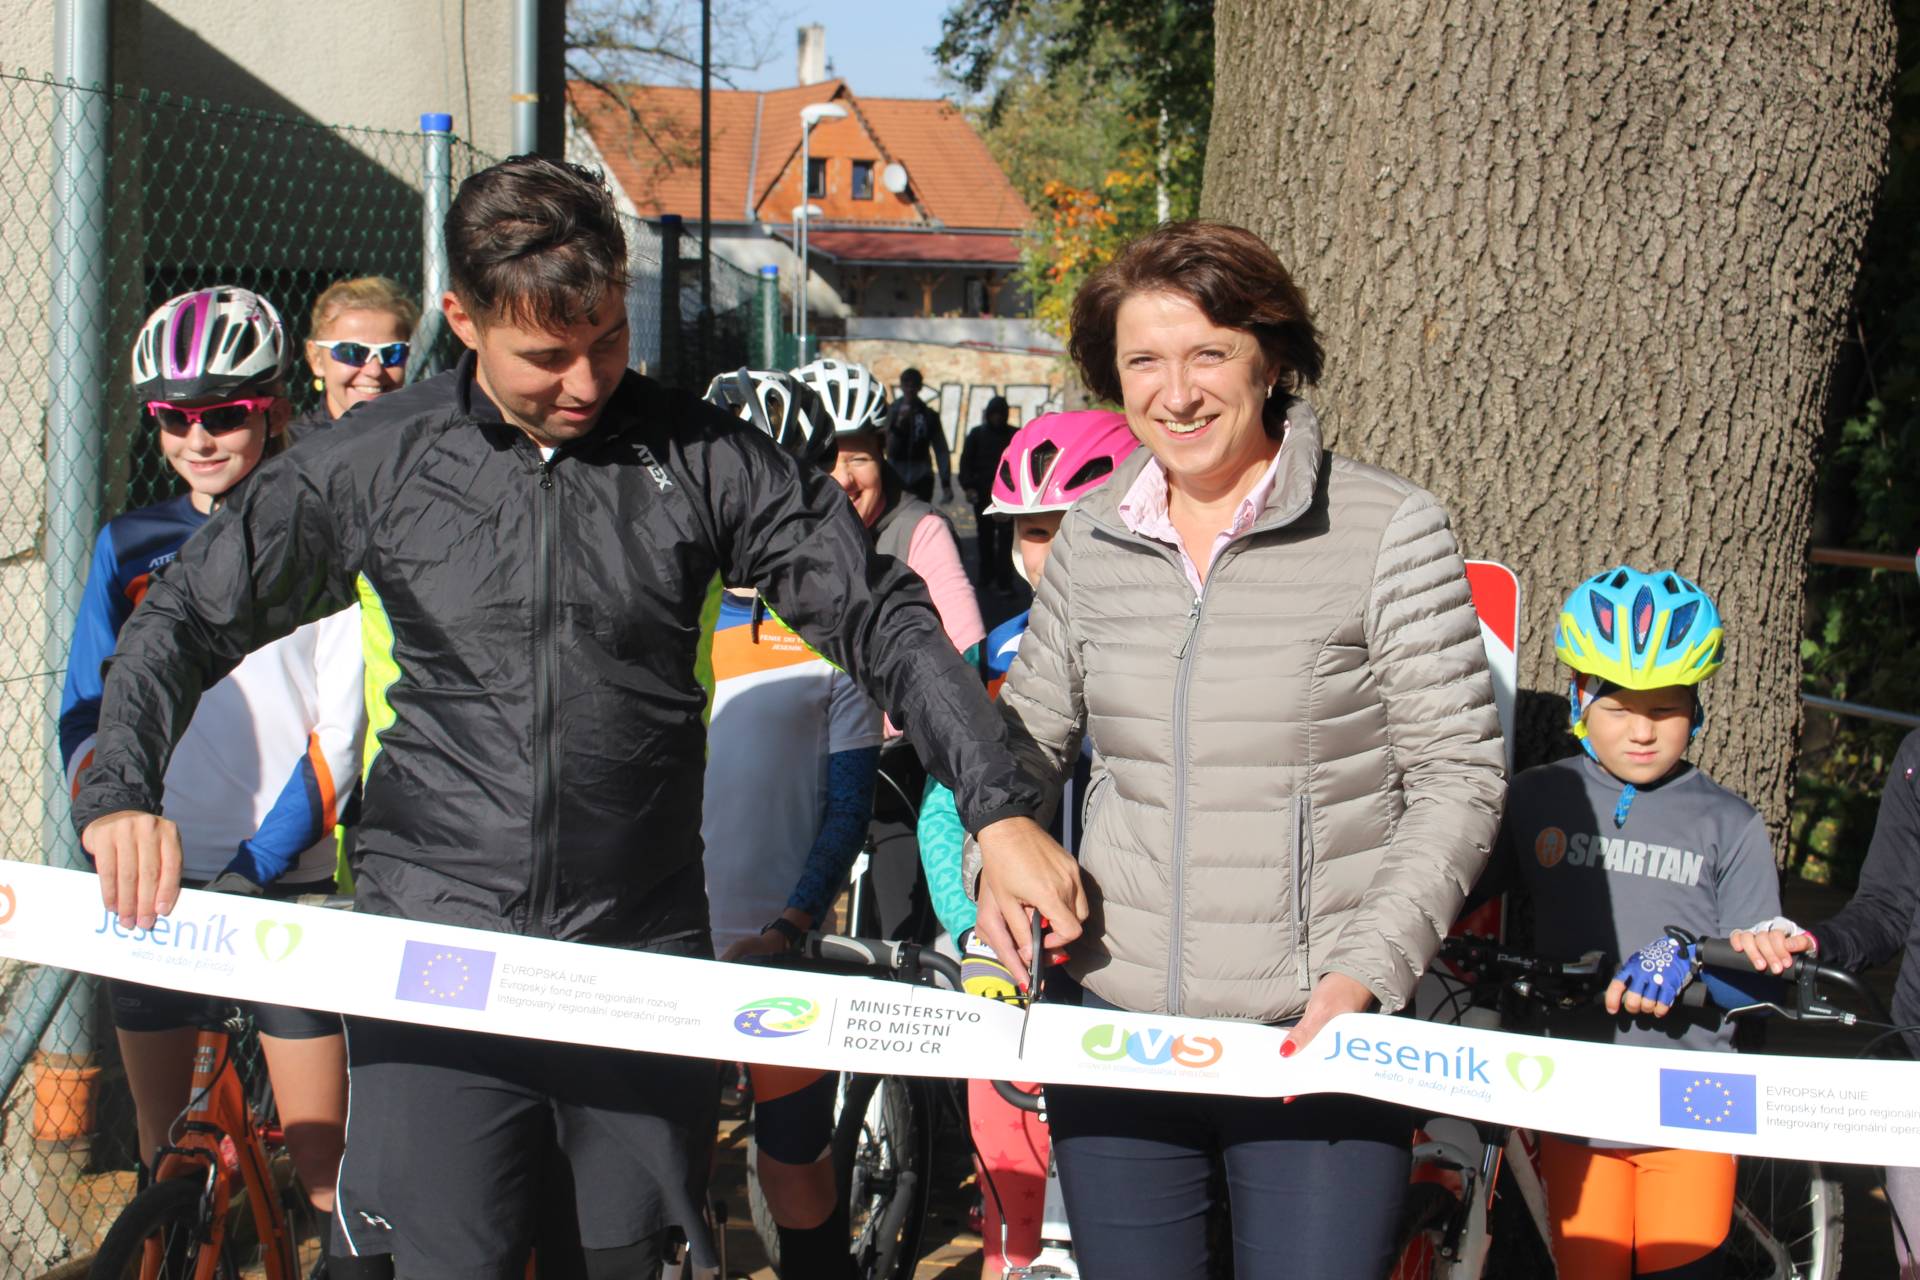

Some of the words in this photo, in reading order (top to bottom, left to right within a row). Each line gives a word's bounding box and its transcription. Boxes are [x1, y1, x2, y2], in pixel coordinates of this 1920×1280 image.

[1567, 832, 1704, 887] SPARTAN
[570, 973, 598, 985] UNIE
[499, 978, 547, 996] Evropský
[550, 985, 573, 997] fond
[574, 990, 592, 1000] pro
[646, 998, 680, 1011] rozvoj
[497, 993, 556, 1012] Integrovaný
[657, 1013, 702, 1026] program
[849, 998, 982, 1023] MINISTERSTVO
[846, 1016, 882, 1033] PRO
[889, 1019, 951, 1037] MÍSTNÍ
[843, 1035, 913, 1053] ROZVOJ
[920, 1038, 942, 1054] ČR
[1081, 1023, 1224, 1068] JVS
[1324, 1031, 1490, 1084] Jeseník
[1766, 1085, 1835, 1100] EVROPSKÁ
[1839, 1089, 1870, 1101] UNIE
[1766, 1101, 1817, 1116] Evropský
[1820, 1103, 1845, 1115] fond
[1848, 1107, 1867, 1118] pro
[1766, 1116, 1830, 1132] Integrovaný
